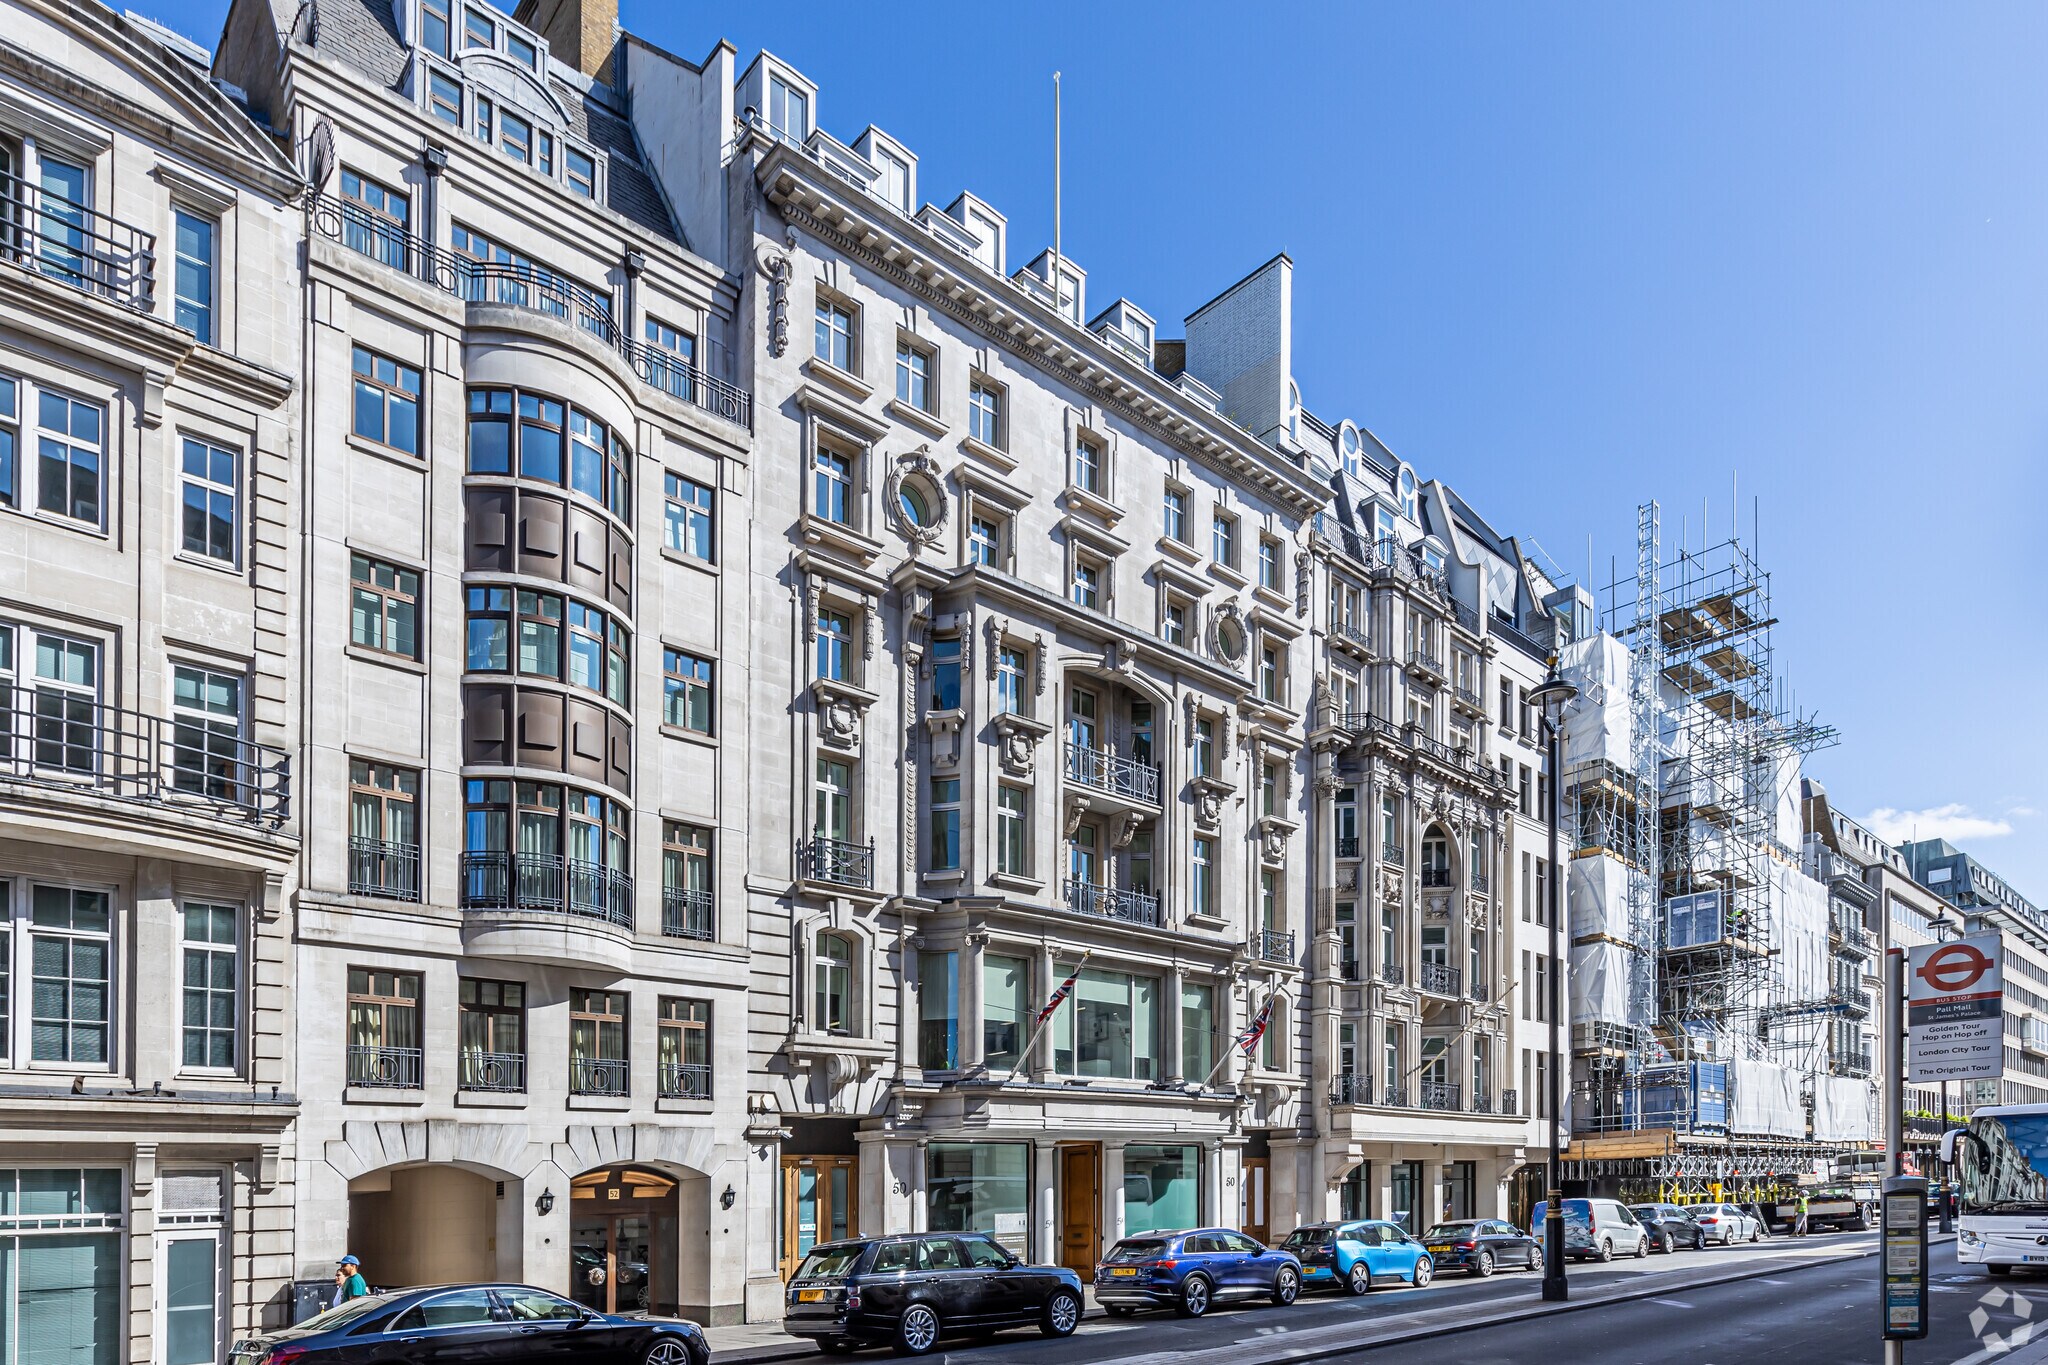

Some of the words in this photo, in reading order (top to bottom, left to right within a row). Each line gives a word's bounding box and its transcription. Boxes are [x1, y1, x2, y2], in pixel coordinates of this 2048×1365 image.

[1936, 1066, 1969, 1074] Original
[1226, 1177, 1235, 1187] 50
[893, 1181, 906, 1194] 50
[610, 1190, 618, 1198] 52
